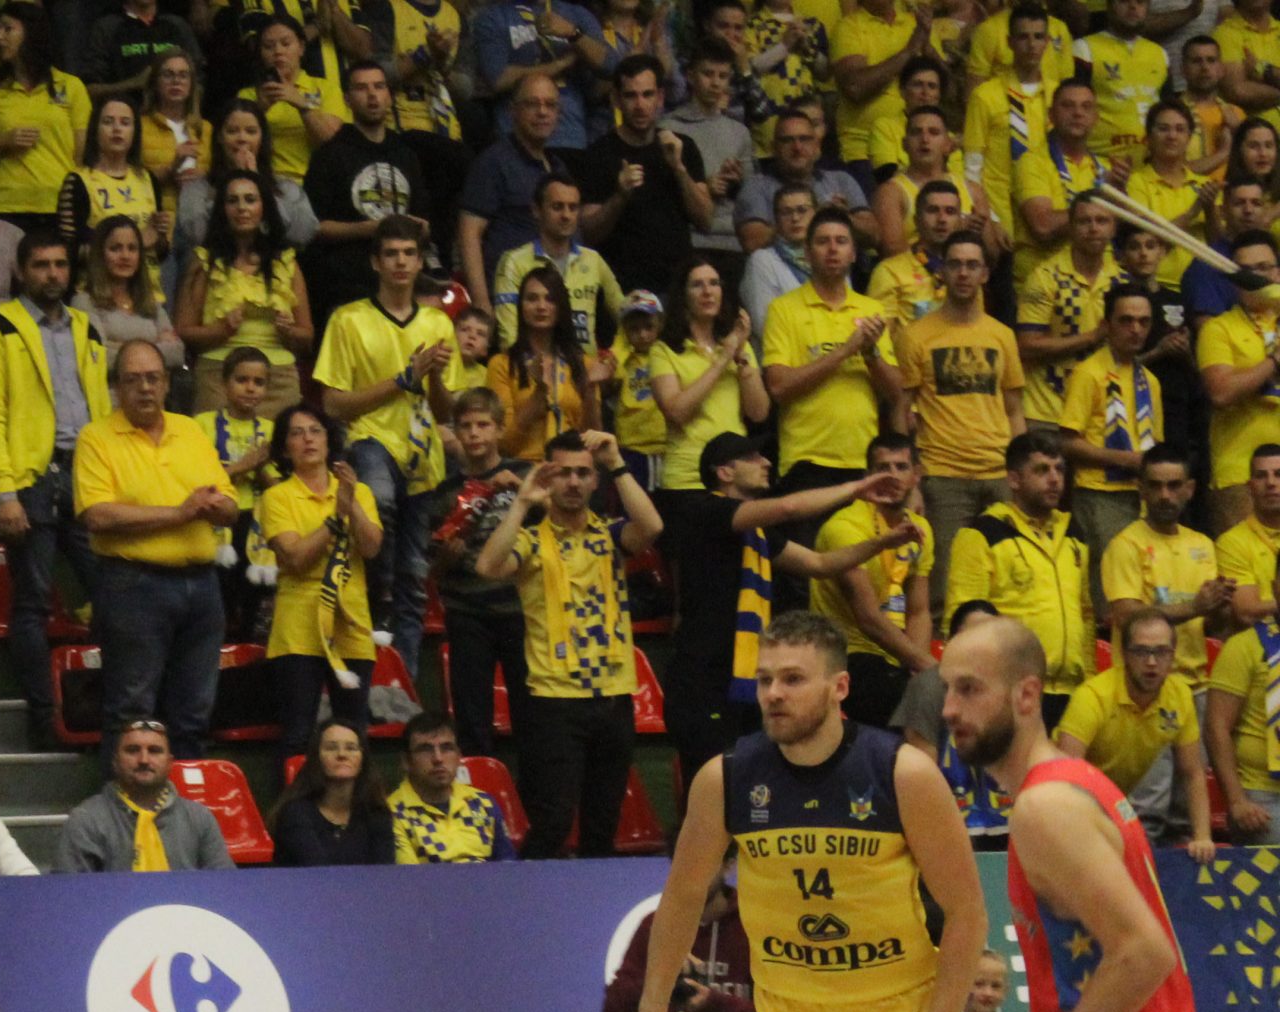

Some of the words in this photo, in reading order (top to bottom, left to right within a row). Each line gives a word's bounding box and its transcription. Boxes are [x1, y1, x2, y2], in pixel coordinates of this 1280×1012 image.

[97, 188, 115, 209] 2
[746, 838, 770, 858] BC
[777, 834, 816, 856] CSU
[825, 836, 881, 857] SIBIU
[792, 867, 834, 900] 14
[762, 935, 906, 969] compa
